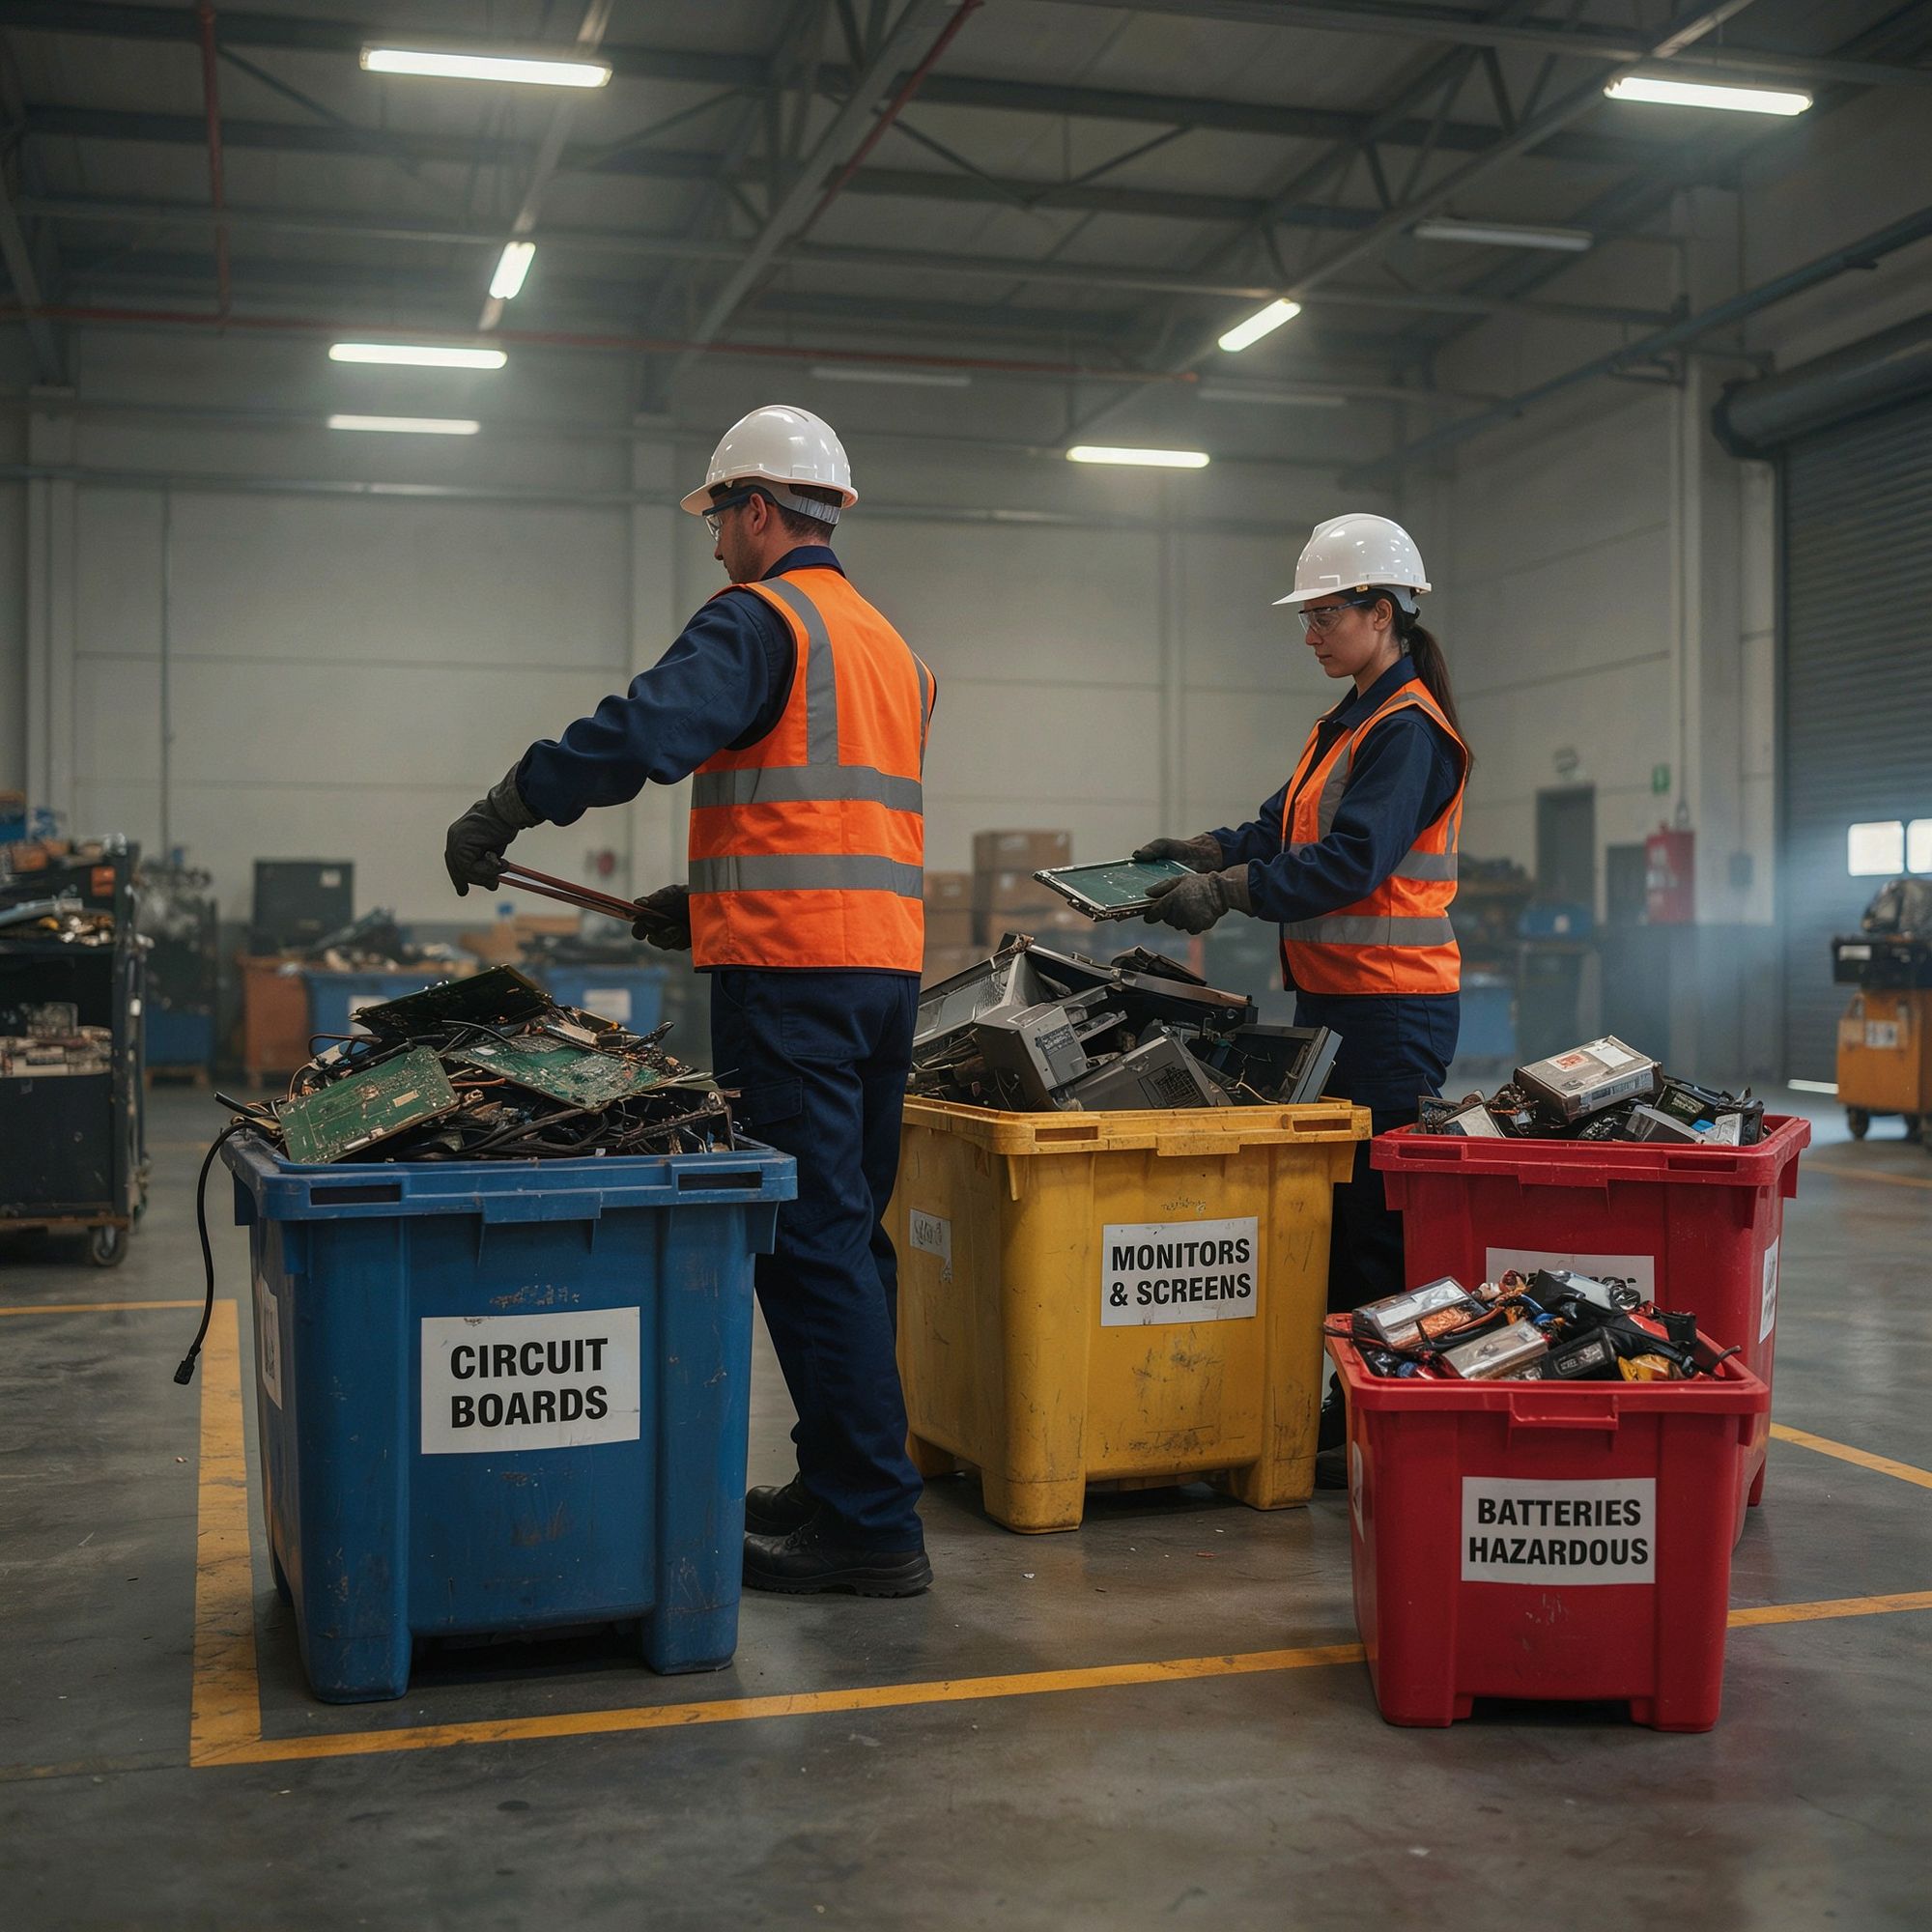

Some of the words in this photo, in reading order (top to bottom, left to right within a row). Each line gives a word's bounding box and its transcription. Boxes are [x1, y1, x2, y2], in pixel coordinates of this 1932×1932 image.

[1112, 1237, 1250, 1270] MONITORS
[1109, 1281, 1128, 1306] &
[1137, 1273, 1251, 1306] SCREENS
[450, 1337, 608, 1379] CIRCUIT
[451, 1385, 608, 1428] BOARDS
[1477, 1497, 1640, 1526] BATTERIES
[1468, 1536, 1648, 1566] HAZARDOUS
